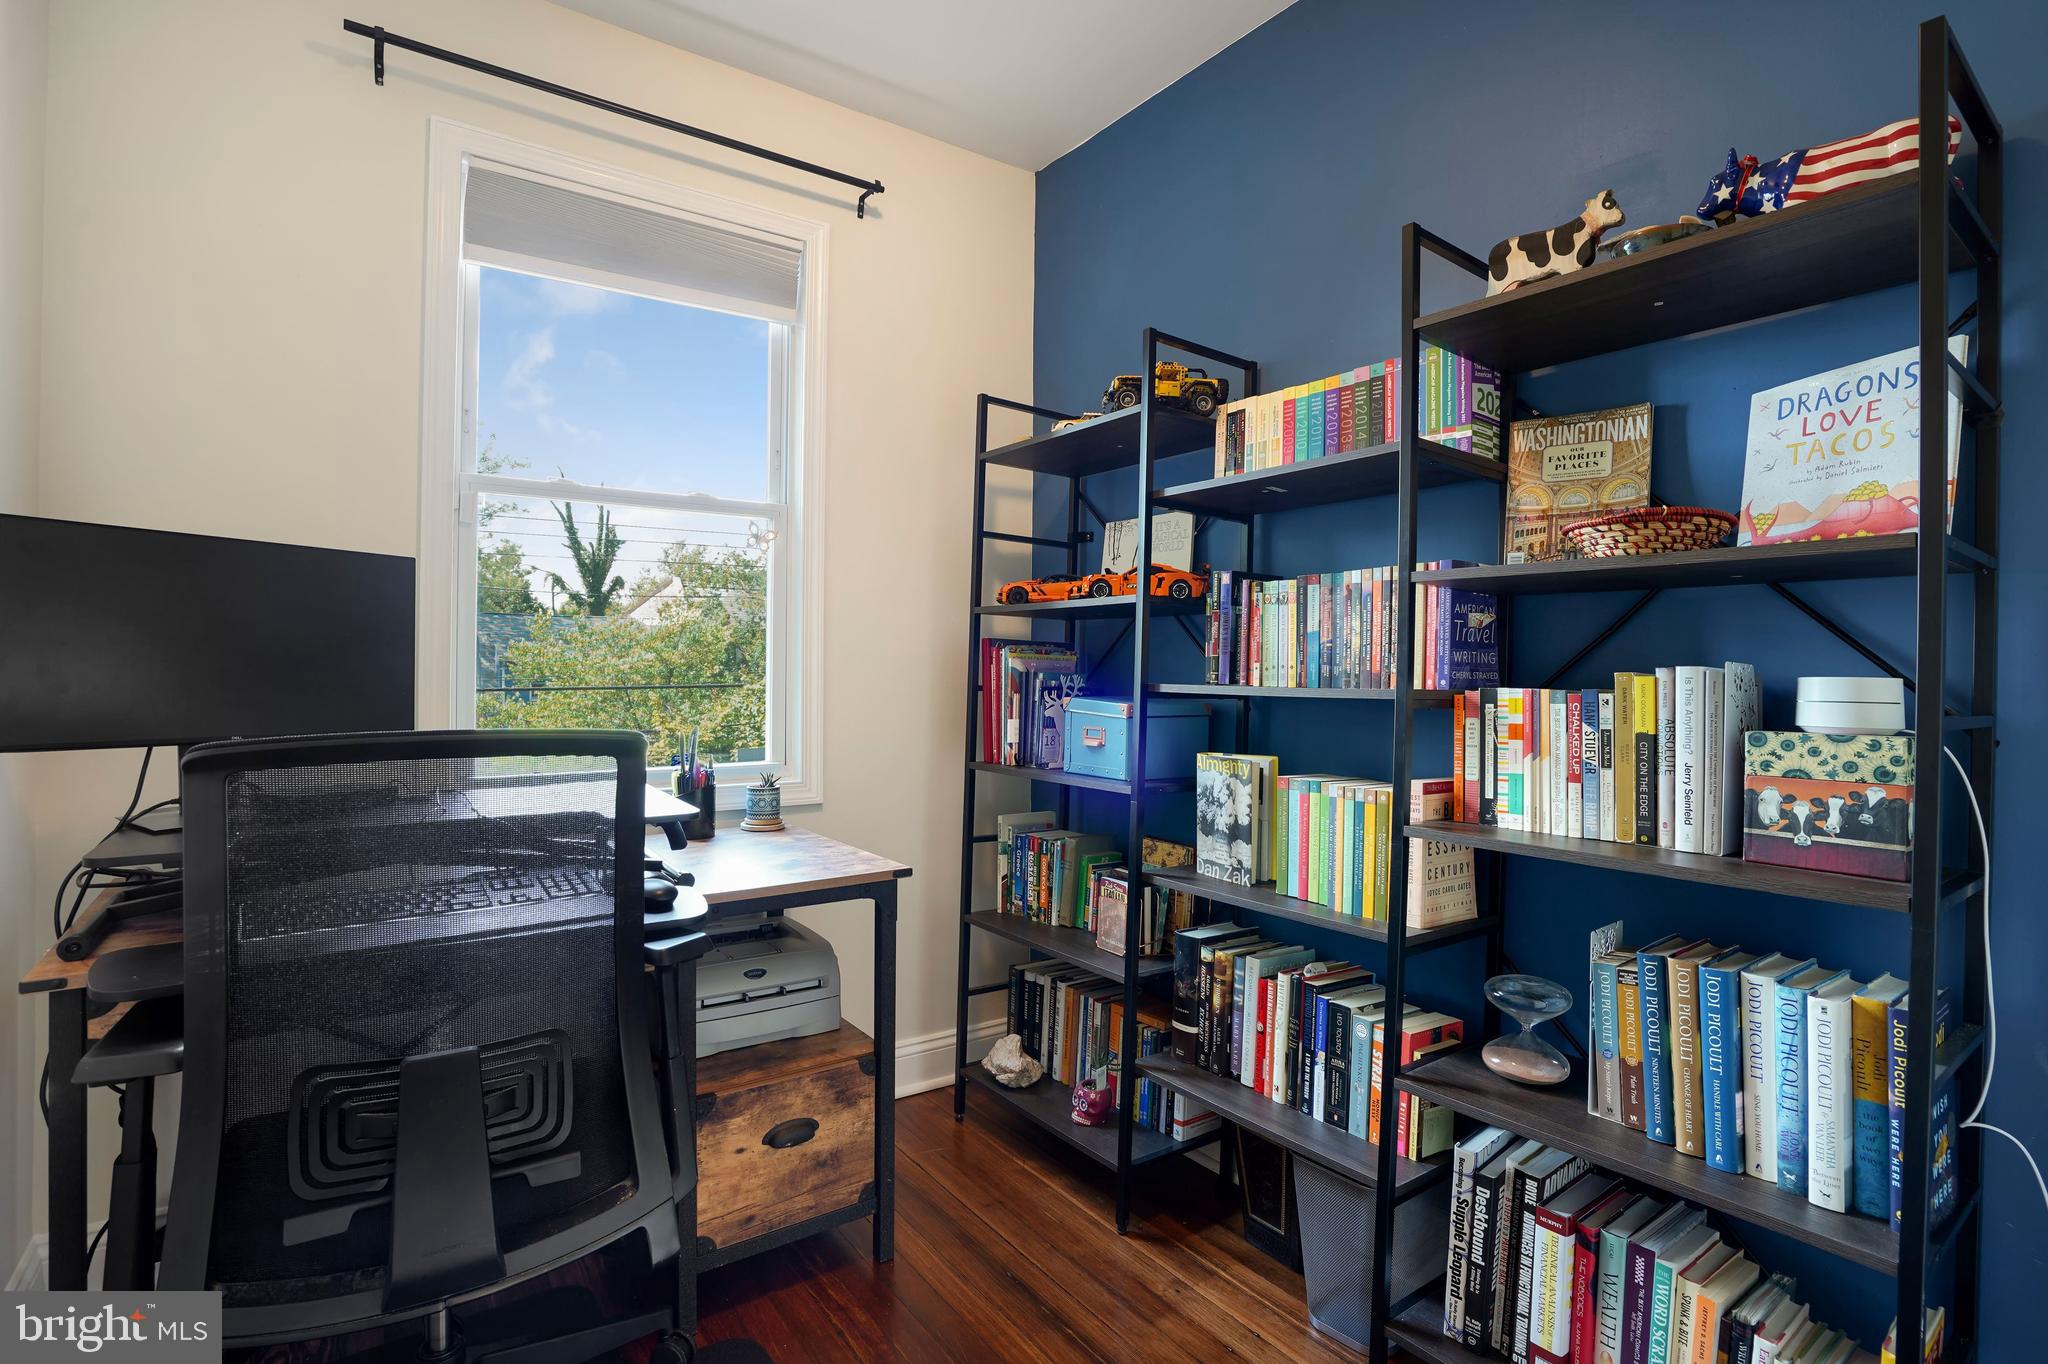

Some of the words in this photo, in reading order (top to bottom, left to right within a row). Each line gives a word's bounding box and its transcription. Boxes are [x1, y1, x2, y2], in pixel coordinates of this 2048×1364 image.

[1777, 361, 1919, 420] DRAGONS
[1311, 417, 1322, 445] 2011
[1327, 412, 1338, 445] 2012
[1342, 410, 1352, 443] 2013
[1356, 406, 1367, 440] 2014
[1372, 401, 1382, 432] 2015
[1802, 399, 1882, 437] LOVE
[1284, 421, 1294, 454] 2009
[1297, 421, 1307, 450] 2010
[1513, 414, 1648, 453] WASHINGTONIAN
[1786, 420, 1895, 465] TACOS
[1548, 450, 1607, 462] FAVORITE
[1555, 460, 1600, 471] PLACES
[1815, 463, 1835, 472] Adam
[1839, 459, 1861, 470] Rubin
[1825, 469, 1848, 480] Daniel
[1455, 603, 1495, 614] AMERICAN
[1454, 620, 1494, 644] Travel
[1453, 651, 1496, 664] WRITING
[1452, 671, 1472, 680] CHERYL
[1473, 671, 1498, 680] STRAYED
[1684, 677, 1694, 685] Is
[1684, 687, 1694, 707] This
[1572, 703, 1580, 756] CHALKED
[1584, 702, 1596, 727] HANK
[1045, 734, 1056, 746] 18
[1455, 730, 1463, 740] THE
[1664, 719, 1675, 776] ABSOLUTE
[1683, 709, 1693, 755] Anything?
[1572, 759, 1580, 774] UP
[1584, 731, 1596, 775] STUEVER
[1640, 742, 1648, 760] CITY
[1197, 756, 1250, 780] Almighty
[1640, 762, 1648, 775] ON
[1683, 762, 1693, 786] Jerry
[1640, 776, 1648, 793] THE
[1585, 802, 1597, 831] RAMP
[1640, 795, 1648, 817] EDGE
[1684, 789, 1693, 826] Seinfeld
[1197, 858, 1220, 879] Dan
[1223, 864, 1250, 887] Zak
[1427, 862, 1470, 880] CENTURY
[1427, 887, 1440, 898] JOYCE
[1442, 884, 1456, 895] CAROL
[1457, 881, 1472, 893] OATES
[1234, 970, 1243, 1005] LIT
[1599, 970, 1611, 996] JODI
[1643, 958, 1658, 991] JODI
[1676, 965, 1691, 998] JODI
[1624, 988, 1634, 1010] JODI
[1705, 974, 1721, 1009] JODI
[1747, 980, 1763, 1015] JODI
[1601, 1000, 1613, 1047] PICOULT
[1625, 1012, 1636, 1053] PICOULT
[1646, 996, 1660, 1056] PICOULT
[1779, 997, 1799, 1037] JODI
[1678, 1003, 1693, 1064] PICOULT
[1708, 1013, 1722, 1076] PICOULT
[1816, 1018, 1831, 1049] JODI
[1893, 1020, 1907, 1052] Jodi
[1749, 1020, 1763, 1084] PICOULT
[1855, 1038, 1872, 1091] Picoult
[1872, 1054, 1886, 1081] Jodi
[1371, 1049, 1382, 1092] STRAY
[1651, 1057, 1660, 1092] NINETEEN
[1683, 1067, 1691, 1097] CHANGE
[1780, 1040, 1800, 1116] PICOULT
[1816, 1054, 1832, 1112] PICOULT
[1893, 1056, 1906, 1108] Picoult
[1653, 1094, 1661, 1124] MINUTES
[1684, 1099, 1691, 1108] OF
[1713, 1080, 1721, 1110] HANDLE
[1684, 1109, 1692, 1134] HEART
[1714, 1111, 1722, 1130] WITH
[1815, 1122, 1825, 1141] VAN
[1858, 1121, 1884, 1134] book
[1890, 1120, 1900, 1150] WERE
[1780, 1130, 1789, 1161] WOLF
[1790, 1130, 1799, 1161] LONE
[1815, 1143, 1825, 1162] LEER
[1825, 1120, 1836, 1170] SAMANTHA
[1866, 1136, 1879, 1144] of
[1455, 1157, 1465, 1189] Becoming
[1544, 1157, 1590, 1200] ADVANCES
[1891, 1157, 1900, 1188] HERE
[1932, 1150, 1951, 1180] WERE
[1524, 1178, 1537, 1206] BOYLE
[1934, 1178, 1952, 1210] HERE
[1453, 1196, 1469, 1242] Supple
[1471, 1186, 1490, 1266] Deskbound
[1521, 1211, 1535, 1255] ADVANCES
[1540, 1216, 1563, 1229] MURPHY
[1449, 1244, 1466, 1301] Leopard
[1521, 1256, 1533, 1265] IN
[1539, 1242, 1549, 1285] FINANCIAL
[1550, 1236, 1559, 1284] TECHNICAL
[1579, 1257, 1587, 1273] THE
[1517, 1266, 1532, 1316] FUNCTIONAL
[1576, 1274, 1586, 1317] NOBODIES
[1656, 1283, 1670, 1326] WORD
[1679, 1293, 1692, 1318] SPUNK
[1537, 1287, 1547, 1334] MARKETS
[1548, 1286, 1558, 1328] ANALYSIS
[1600, 1272, 1619, 1350] WEALTH
[1515, 1317, 1529, 1355] TRAINING
[1678, 1328, 1689, 1347] BITE
